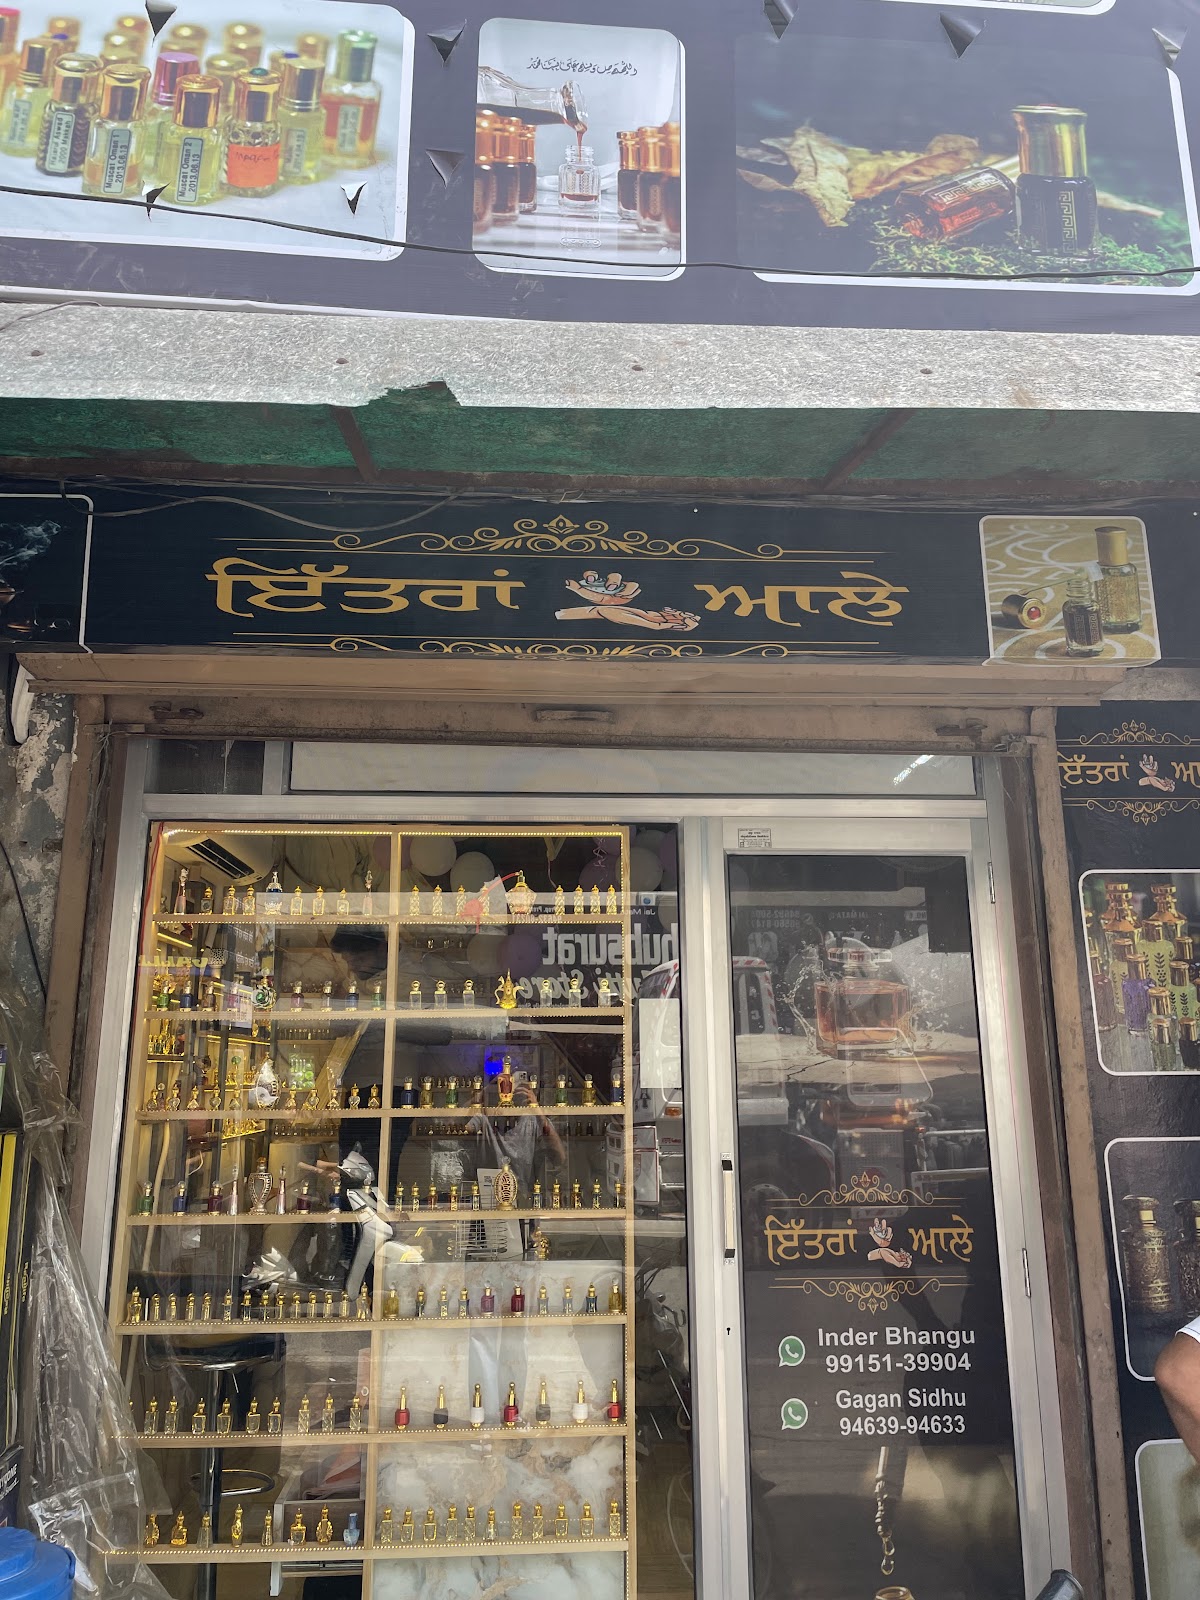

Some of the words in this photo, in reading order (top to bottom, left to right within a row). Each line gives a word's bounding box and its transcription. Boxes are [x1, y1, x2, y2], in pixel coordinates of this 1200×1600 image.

[110, 140, 120, 162] Oman
[182, 148, 191, 170] Oman
[105, 163, 116, 189] Muscat
[177, 170, 188, 197] Muscat
[205, 557, 526, 618] ਇੱਤਰਾਂ
[693, 571, 910, 628] ਆਲੇ
[764, 1214, 857, 1265] ਇੱਤਰਾਂ
[908, 1214, 974, 1263] ਆਲੇ
[818, 1328, 877, 1346] Inder
[886, 1327, 975, 1349] Bhangu
[825, 1352, 971, 1373] 99151-39904
[836, 1389, 902, 1413] Gagan
[908, 1388, 966, 1408] Sidhu
[839, 1415, 966, 1435] 94639-94633
